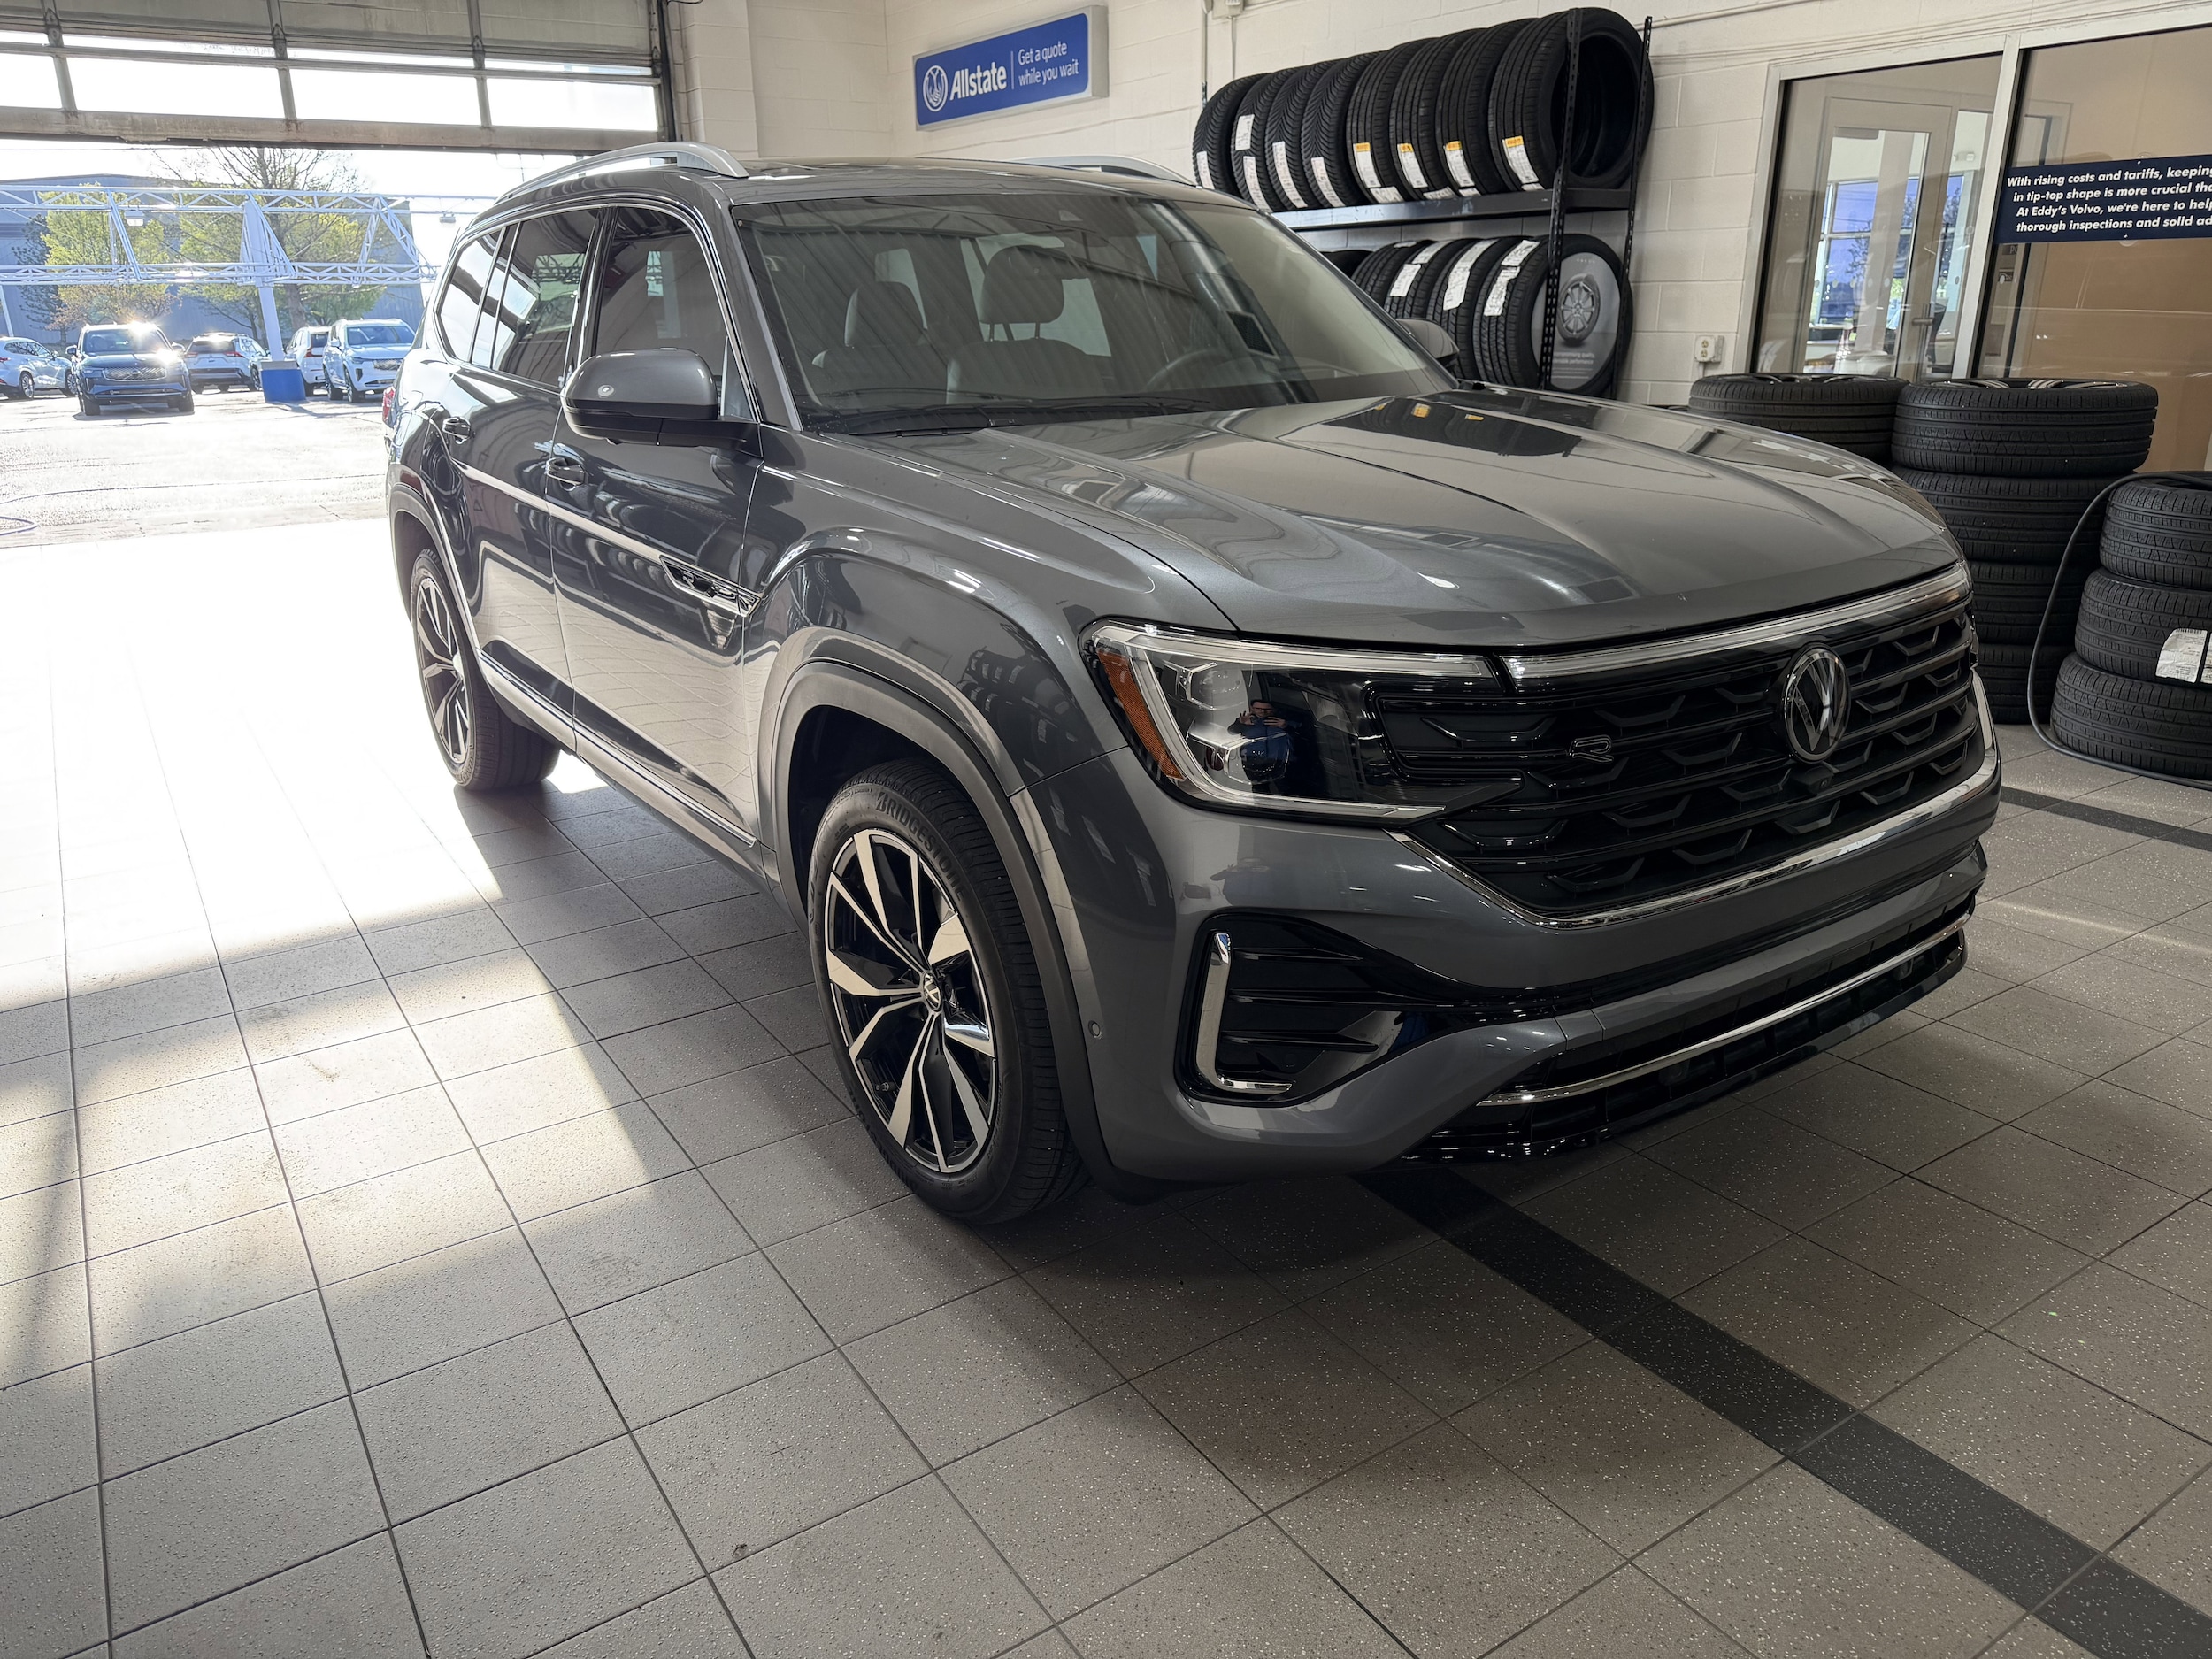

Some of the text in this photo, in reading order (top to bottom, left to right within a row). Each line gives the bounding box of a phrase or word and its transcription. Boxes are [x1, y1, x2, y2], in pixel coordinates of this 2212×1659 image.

[1018, 49, 1034, 65] Get
[1041, 41, 1067, 64] quote
[949, 62, 1007, 101] Allstate
[1018, 61, 1079, 87] while you wait
[2007, 176, 2032, 187] With
[2033, 174, 2065, 187] rising
[2068, 173, 2095, 183] costs
[2098, 170, 2122, 181] and
[2124, 168, 2163, 180] tariffs,
[2013, 192, 2024, 202] in
[2026, 191, 2064, 204] tip-top
[2066, 188, 2101, 201] shape
[2104, 187, 2114, 197] is
[2116, 187, 2148, 196] more
[2151, 181, 2193, 195] crucial
[2016, 207, 2030, 217] At
[2032, 205, 2067, 218] Eddy’s
[2070, 204, 2104, 215] Volvo,
[2108, 203, 2139, 212] we're
[2141, 201, 2170, 211] here
[2173, 200, 2185, 211] to
[2016, 214, 2212, 233] thorough inspections and solid ad
[875, 791, 966, 902] BRIDGESTONE
